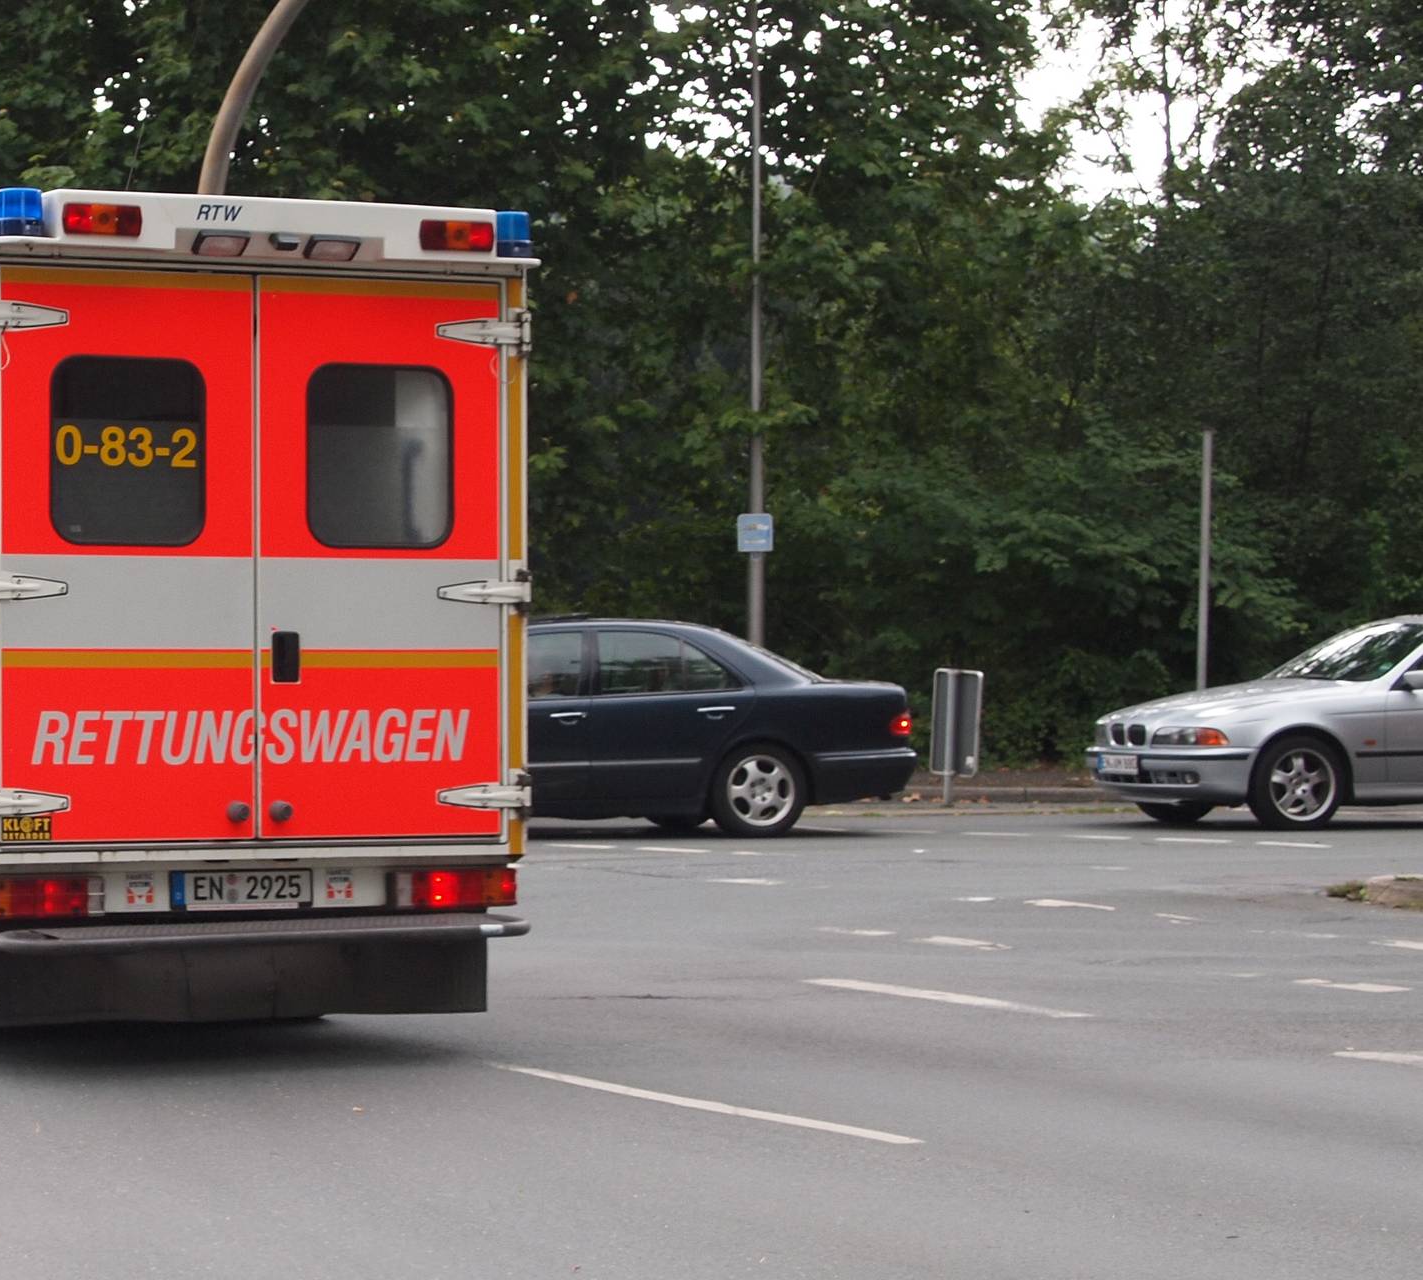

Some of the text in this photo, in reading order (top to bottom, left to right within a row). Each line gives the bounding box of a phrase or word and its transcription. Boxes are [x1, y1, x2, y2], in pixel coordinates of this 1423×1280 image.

[197, 204, 243, 221] RTW
[55, 424, 197, 468] 0-83-2
[30, 708, 470, 766] RETTUNGSWAGEN
[2, 832, 50, 840] RETARDER
[193, 875, 302, 901] EN 2925
